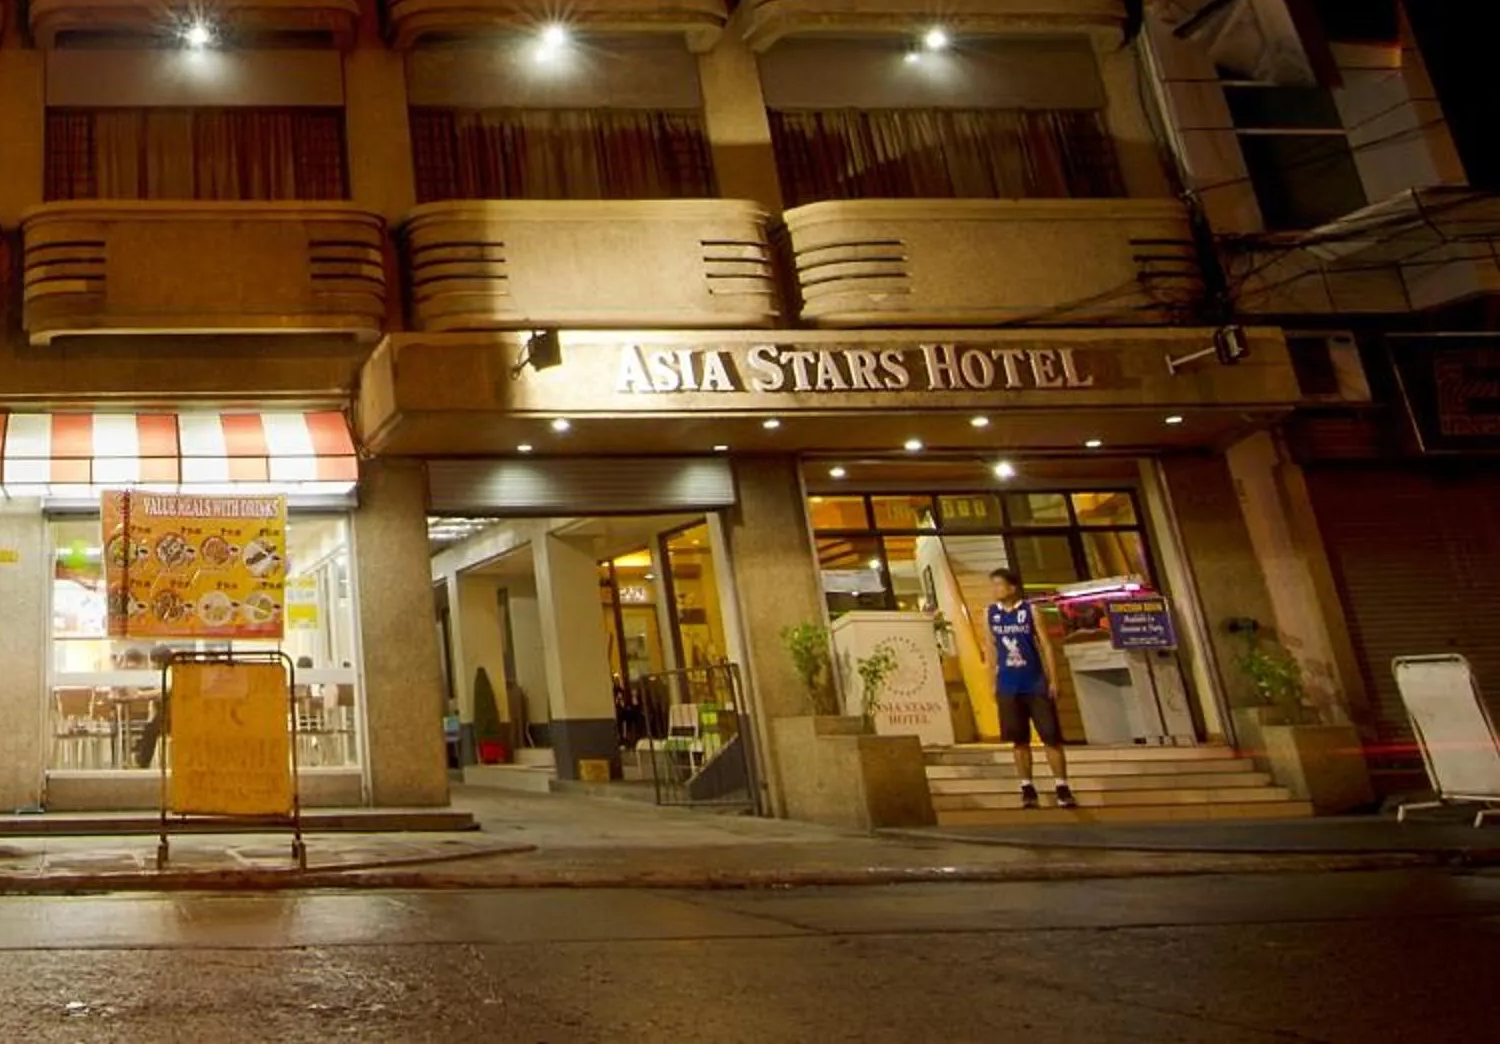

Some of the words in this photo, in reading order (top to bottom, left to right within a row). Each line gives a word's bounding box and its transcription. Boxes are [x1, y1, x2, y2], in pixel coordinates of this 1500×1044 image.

[617, 344, 735, 392] ASIA
[746, 344, 908, 391] STARS
[919, 344, 1095, 390] HOTEL
[143, 496, 177, 516] VALUE
[177, 497, 212, 517] MEALS
[212, 498, 239, 517] WITH
[239, 498, 279, 517] DRINKS
[889, 714, 931, 725] HOTEL
